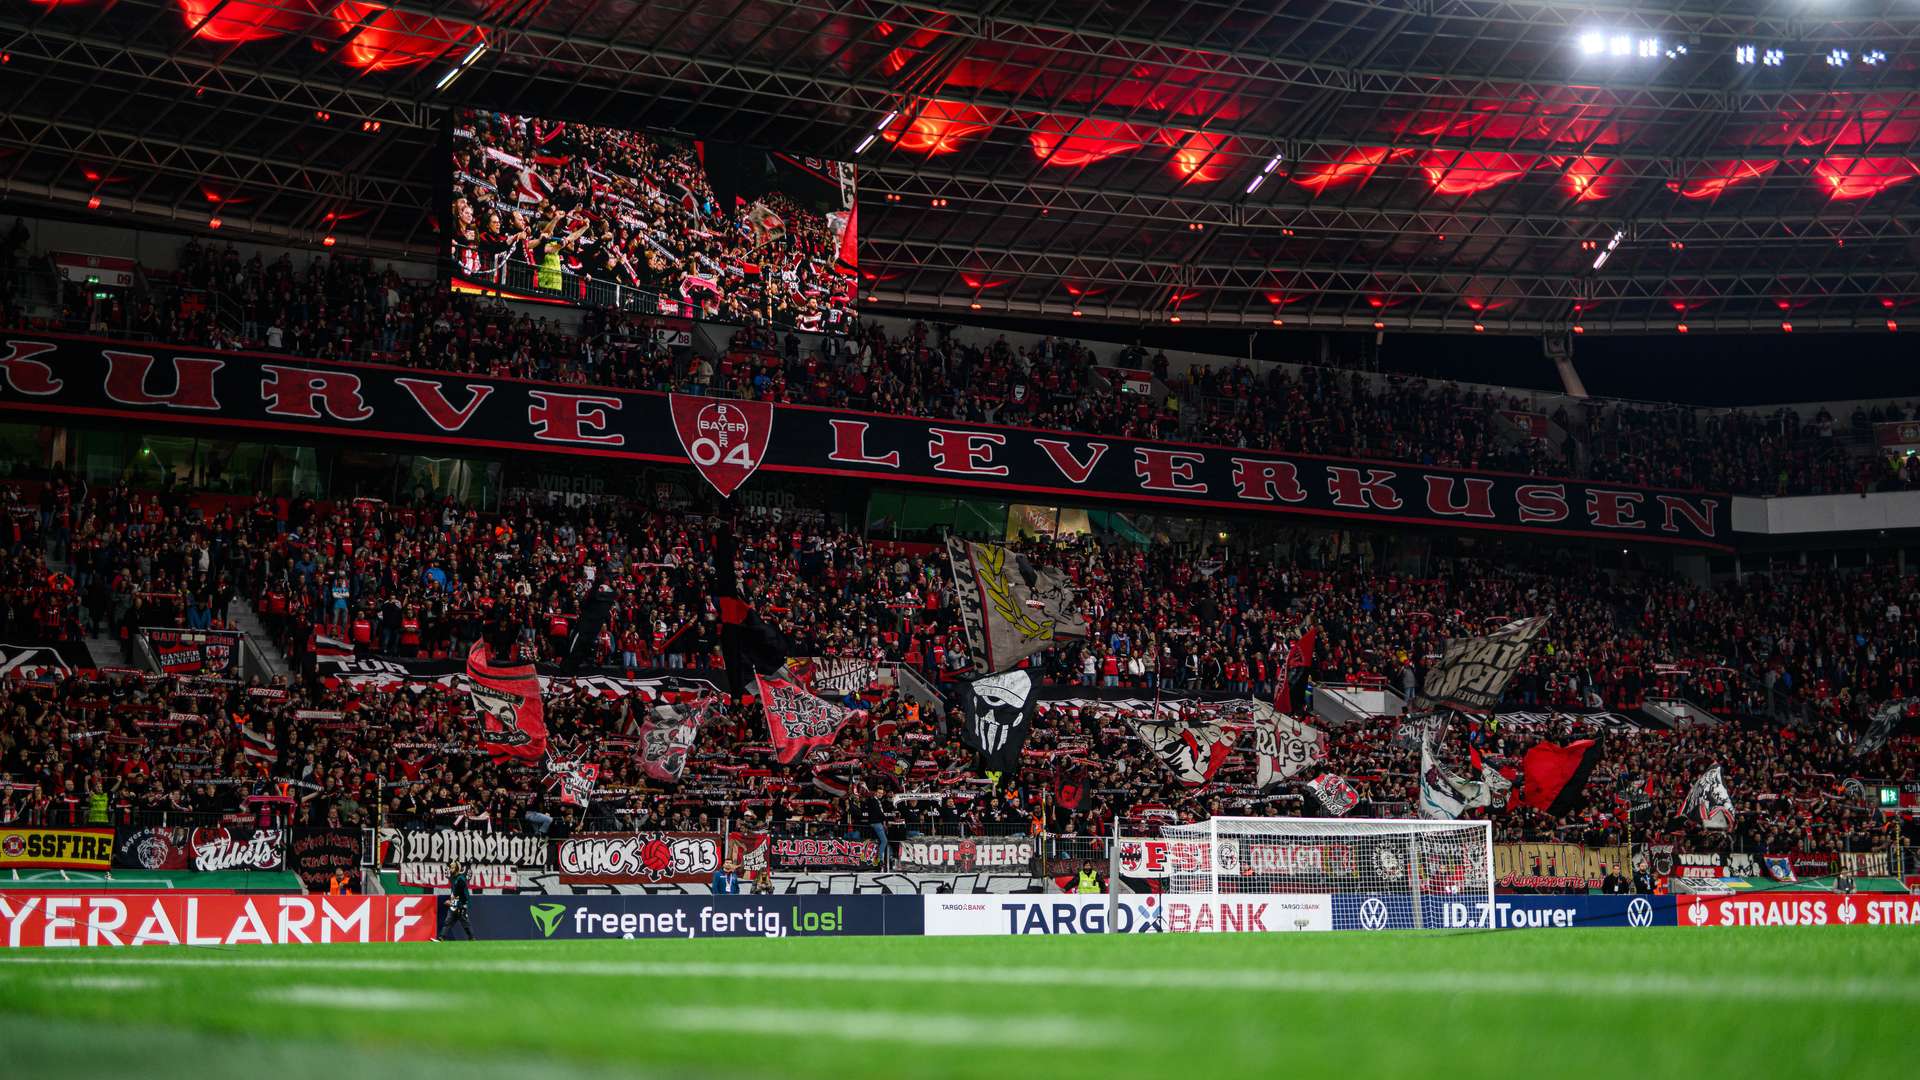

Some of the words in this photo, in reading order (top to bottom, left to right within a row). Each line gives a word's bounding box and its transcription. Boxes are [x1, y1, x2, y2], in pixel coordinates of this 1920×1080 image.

[700, 420, 746, 432] BAYER
[691, 437, 755, 469] 04
[827, 419, 1719, 537] LEVERKUSEN
[27, 833, 112, 861] SSFIRE
[559, 837, 641, 876] CHAOS
[671, 838, 718, 874] 513
[0, 897, 371, 948] YERALARM
[574, 906, 696, 939] freenet,
[699, 906, 788, 938] fertig,
[792, 905, 843, 932] los!
[1443, 903, 1490, 928] ID.7
[1495, 902, 1576, 928] Tourer
[1719, 901, 1828, 926] STRAUSS
